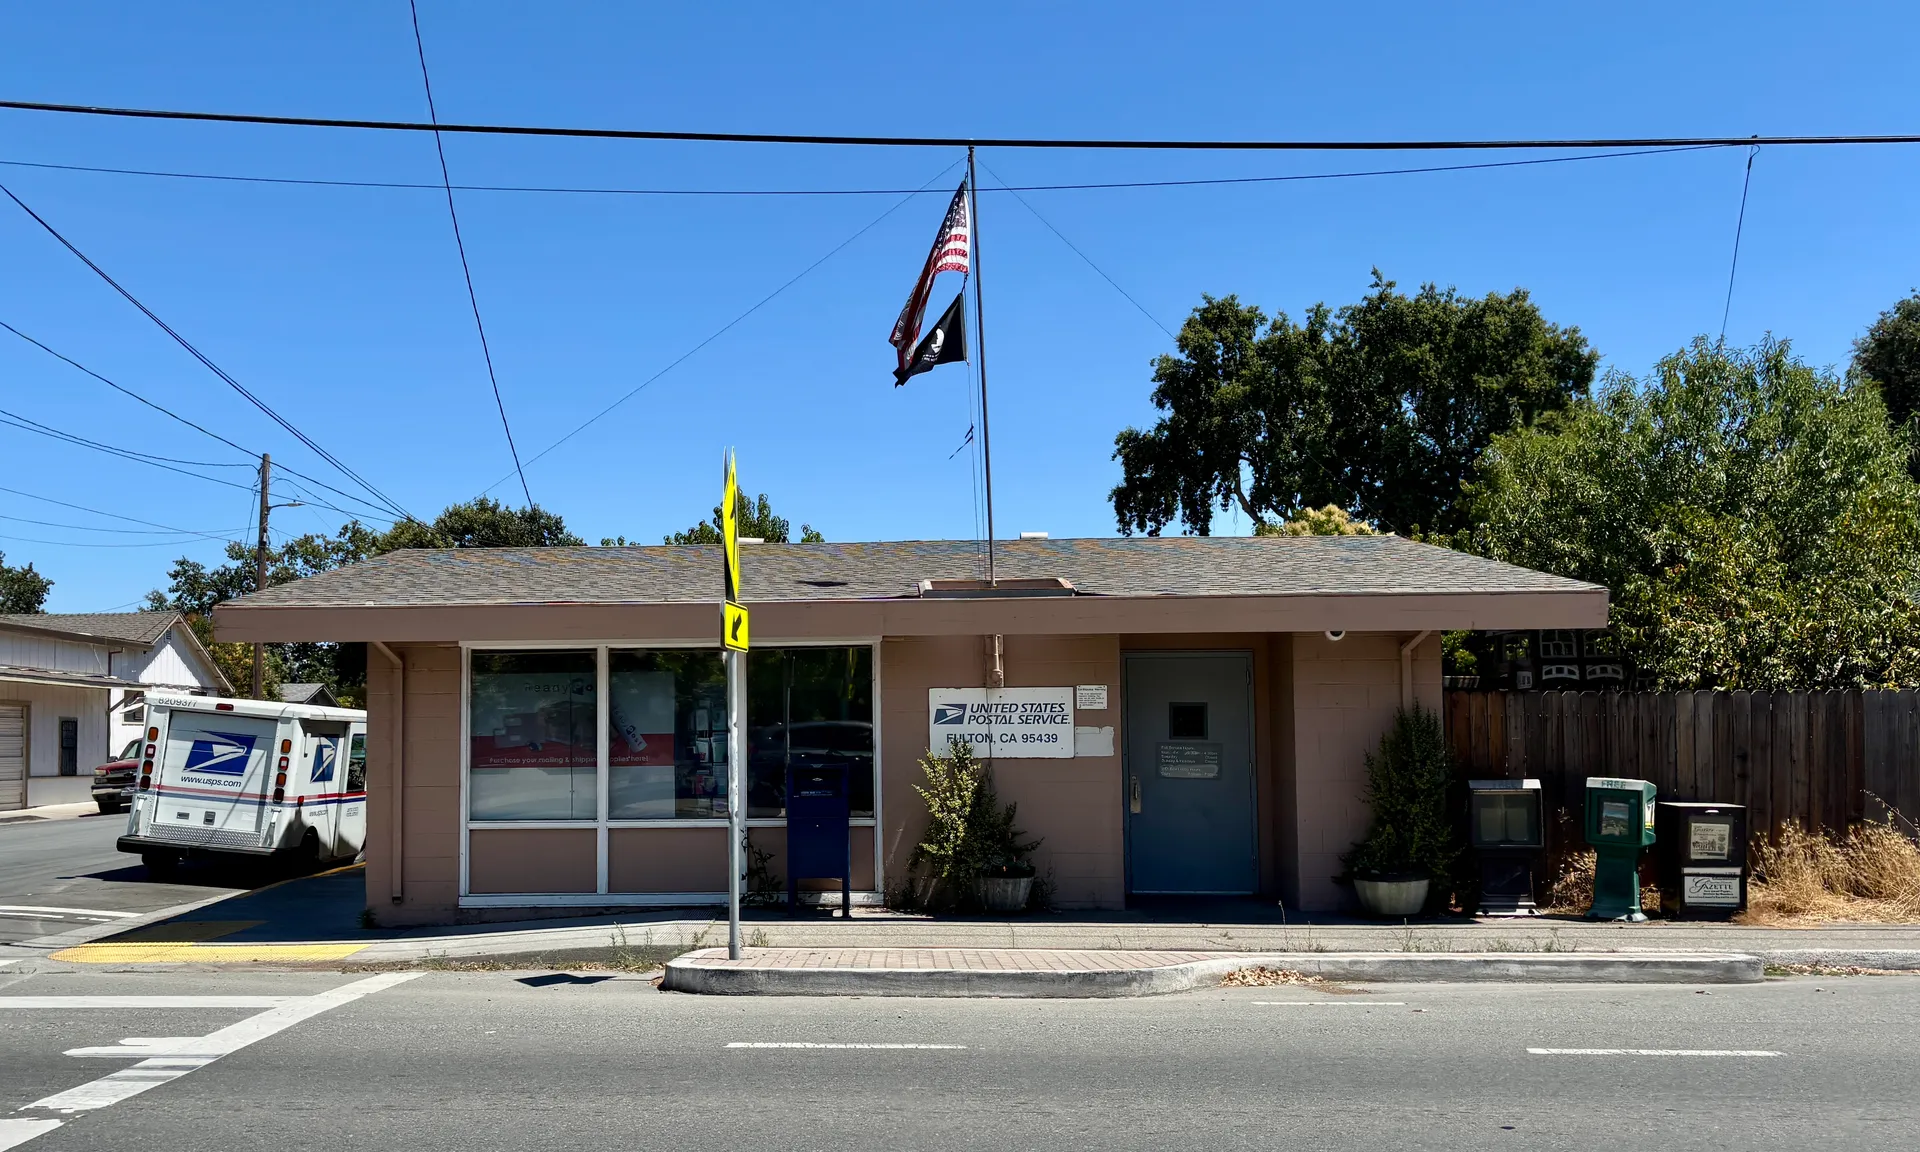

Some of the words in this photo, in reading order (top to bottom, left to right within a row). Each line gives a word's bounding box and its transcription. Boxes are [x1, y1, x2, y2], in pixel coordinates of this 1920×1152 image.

[158, 697, 197, 707] 8209377
[970, 703, 1018, 713] UNITED
[1021, 702, 1066, 713] STATES
[967, 714, 1015, 725] POSTAL
[1000, 733, 1017, 743] CA
[1021, 733, 1058, 743] 95439
[181, 776, 242, 787] www.usps.com
